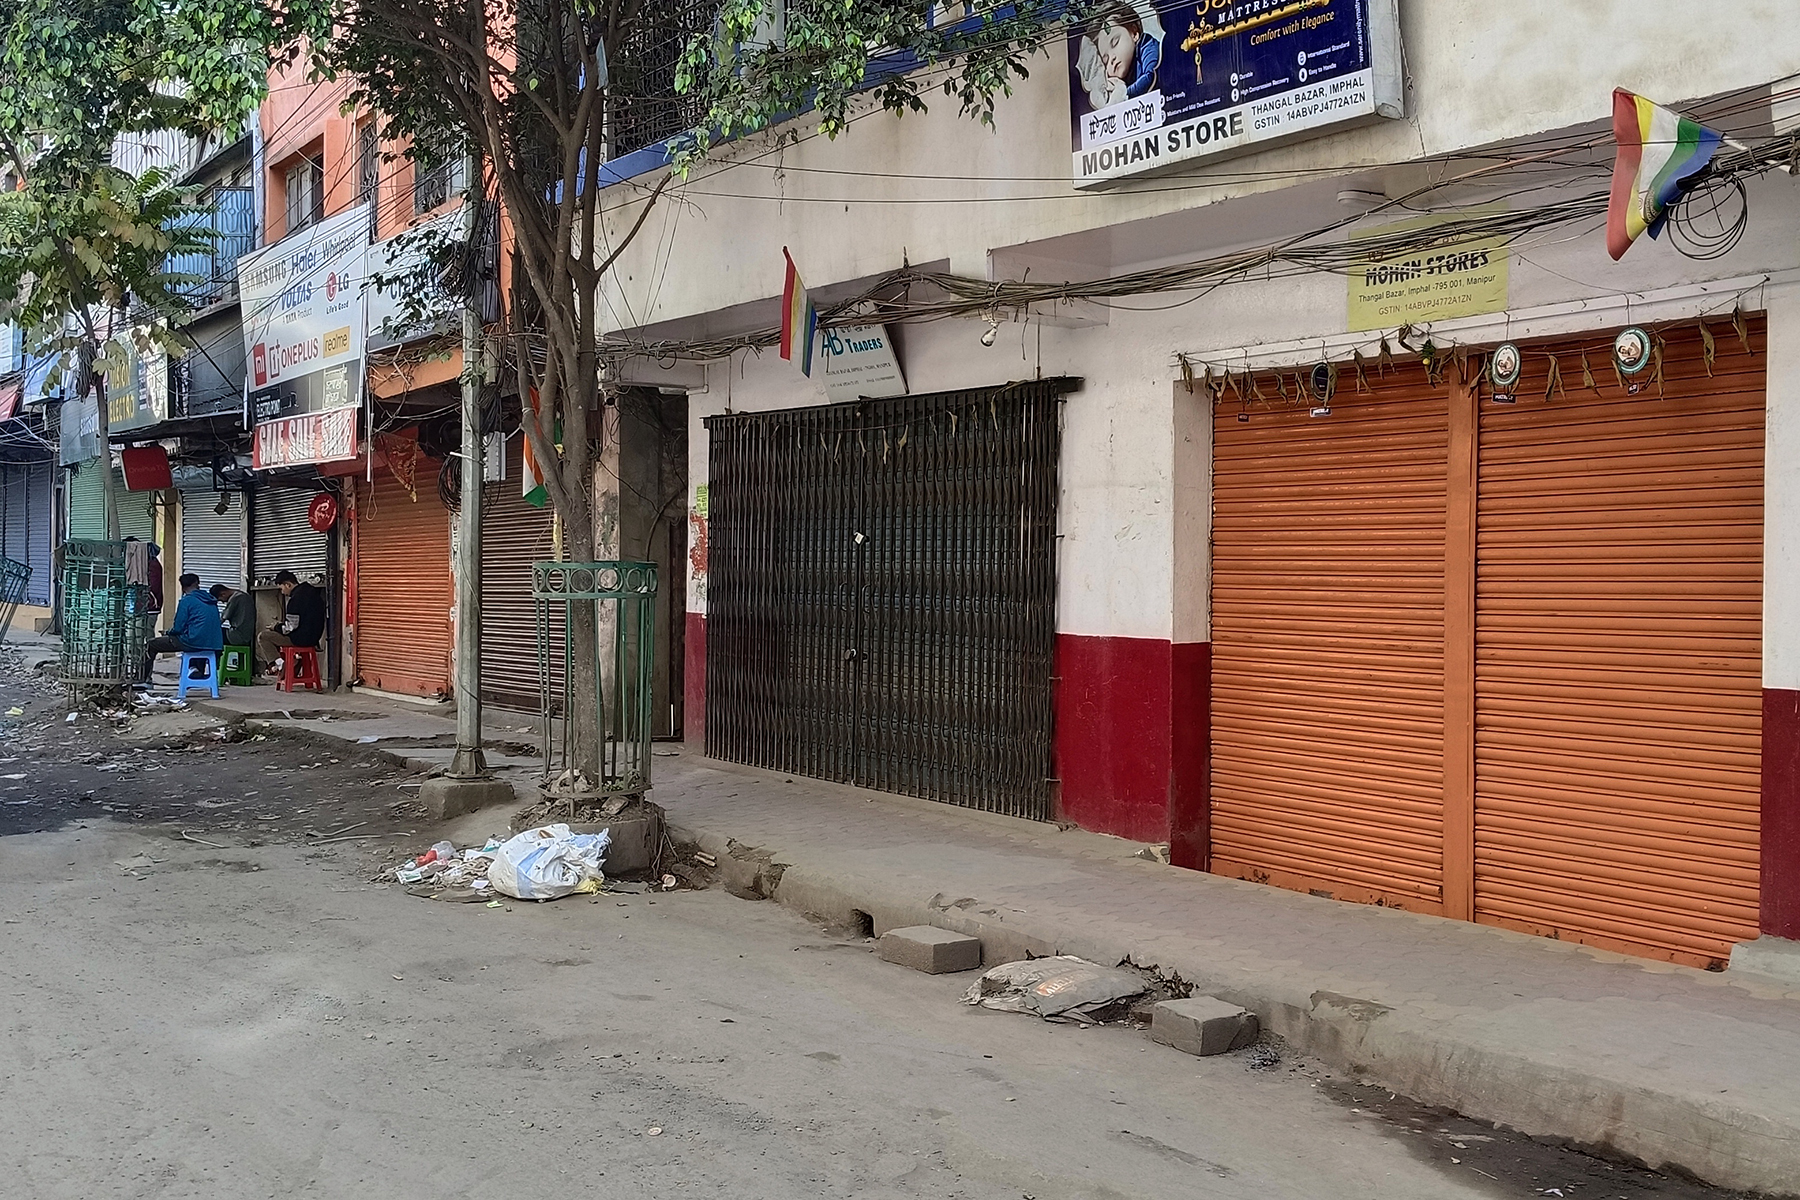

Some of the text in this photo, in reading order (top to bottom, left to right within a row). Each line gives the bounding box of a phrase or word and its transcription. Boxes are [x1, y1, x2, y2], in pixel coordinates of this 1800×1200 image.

[1217, 0, 1286, 24] MATTRES
[1250, 11, 1335, 46] Comfort with Elegance
[1251, 76, 1365, 116] THANGAL BAZAR, IMPHAL
[1254, 114, 1280, 130] GSTIN
[1286, 92, 1366, 122] 14ABVPJ4772A1ZN
[1082, 111, 1244, 176] MOHAN STORE
[244, 260, 287, 294] SAMSUNG
[291, 249, 318, 277] Haier
[338, 273, 350, 292] LG
[1365, 248, 1489, 287] MOHAN STORES
[281, 281, 313, 311] VOLTAS
[1359, 292, 1384, 303] Thangal
[1386, 289, 1407, 299] Bazar,
[1408, 284, 1431, 295] Imphal
[1467, 275, 1496, 286] Manipur
[1405, 294, 1472, 311] 14ABVPJ4772A1ZN
[338, 300, 349, 311] Good
[281, 338, 319, 368] ONEPLUS
[325, 333, 348, 352] realme
[821, 327, 844, 358] AB
[109, 393, 135, 424] ELECTRO
[259, 421, 285, 466] SALE
[288, 416, 316, 462] SALE
